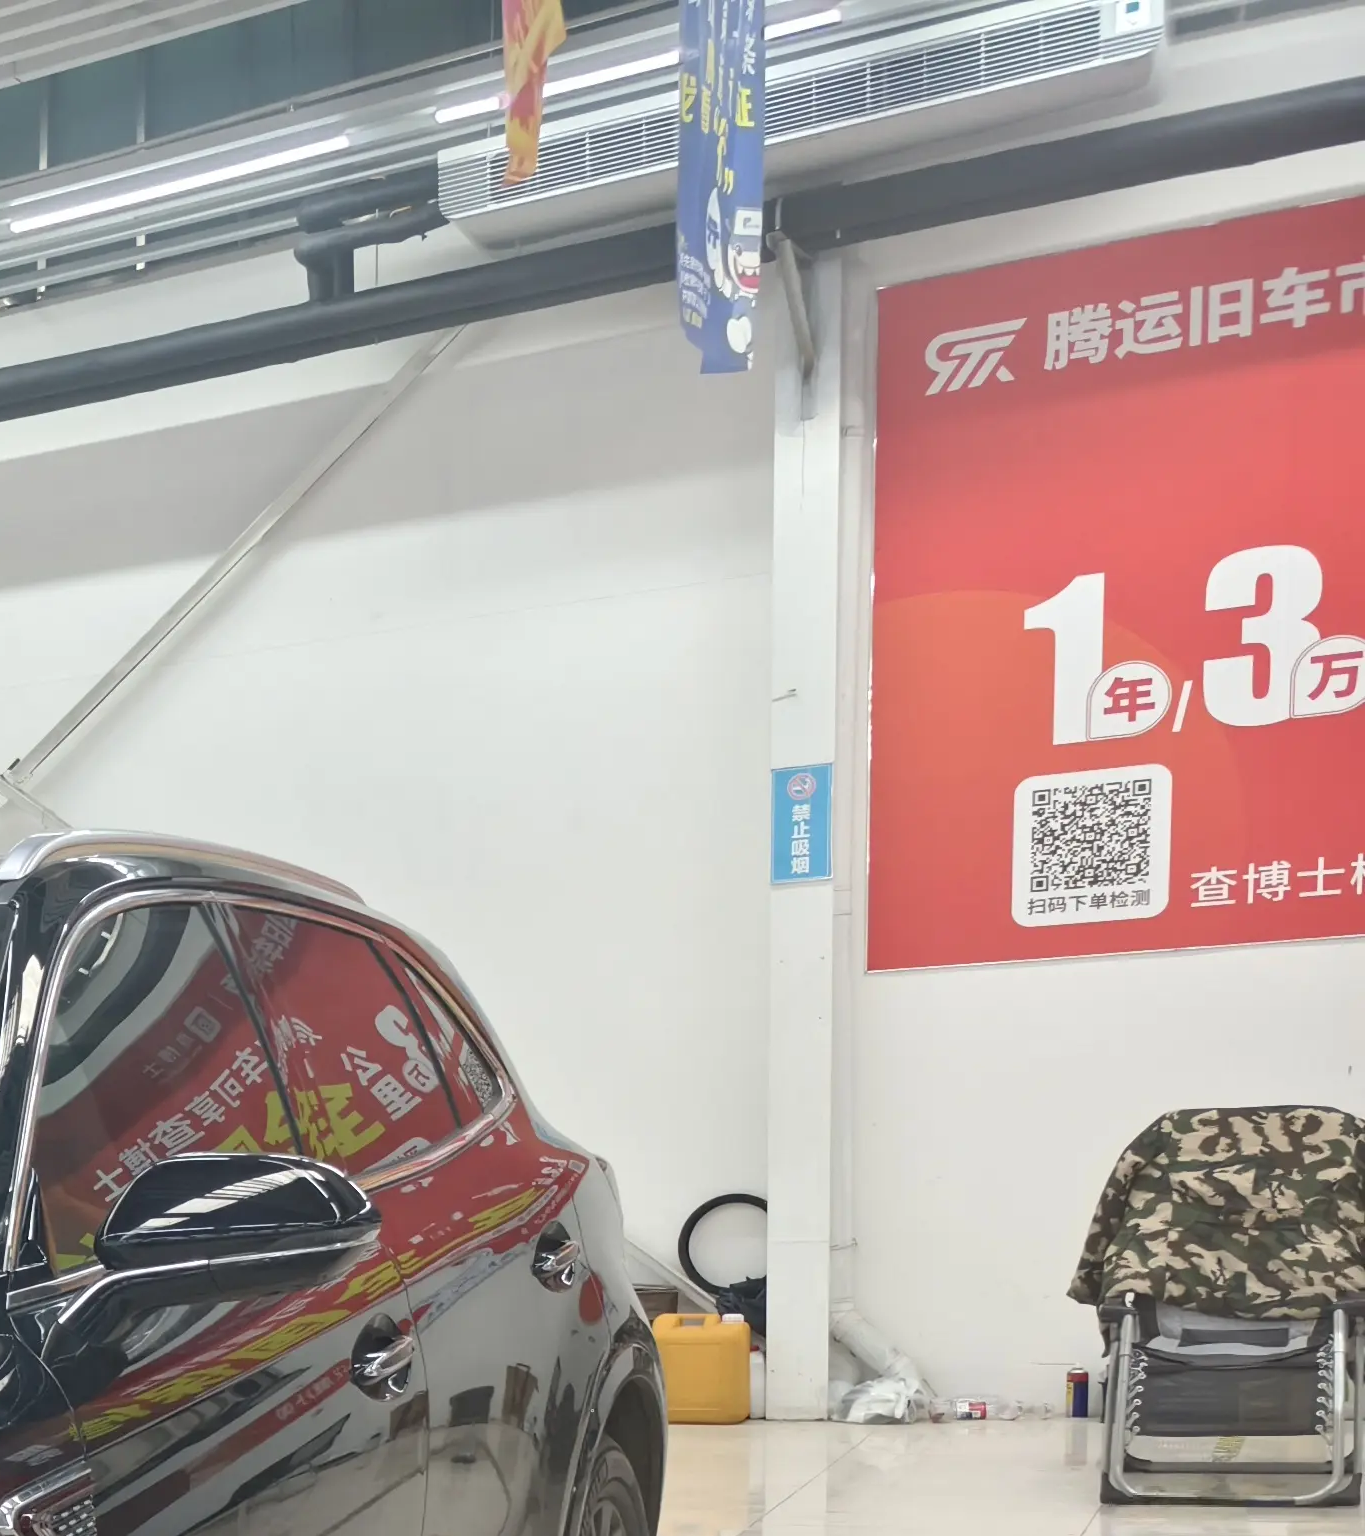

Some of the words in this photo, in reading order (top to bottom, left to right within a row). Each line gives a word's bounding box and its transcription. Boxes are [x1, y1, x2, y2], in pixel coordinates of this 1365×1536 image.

[791, 803, 811, 875] 禁止吸烟
[1027, 888, 1151, 916] 扫码下单检测
